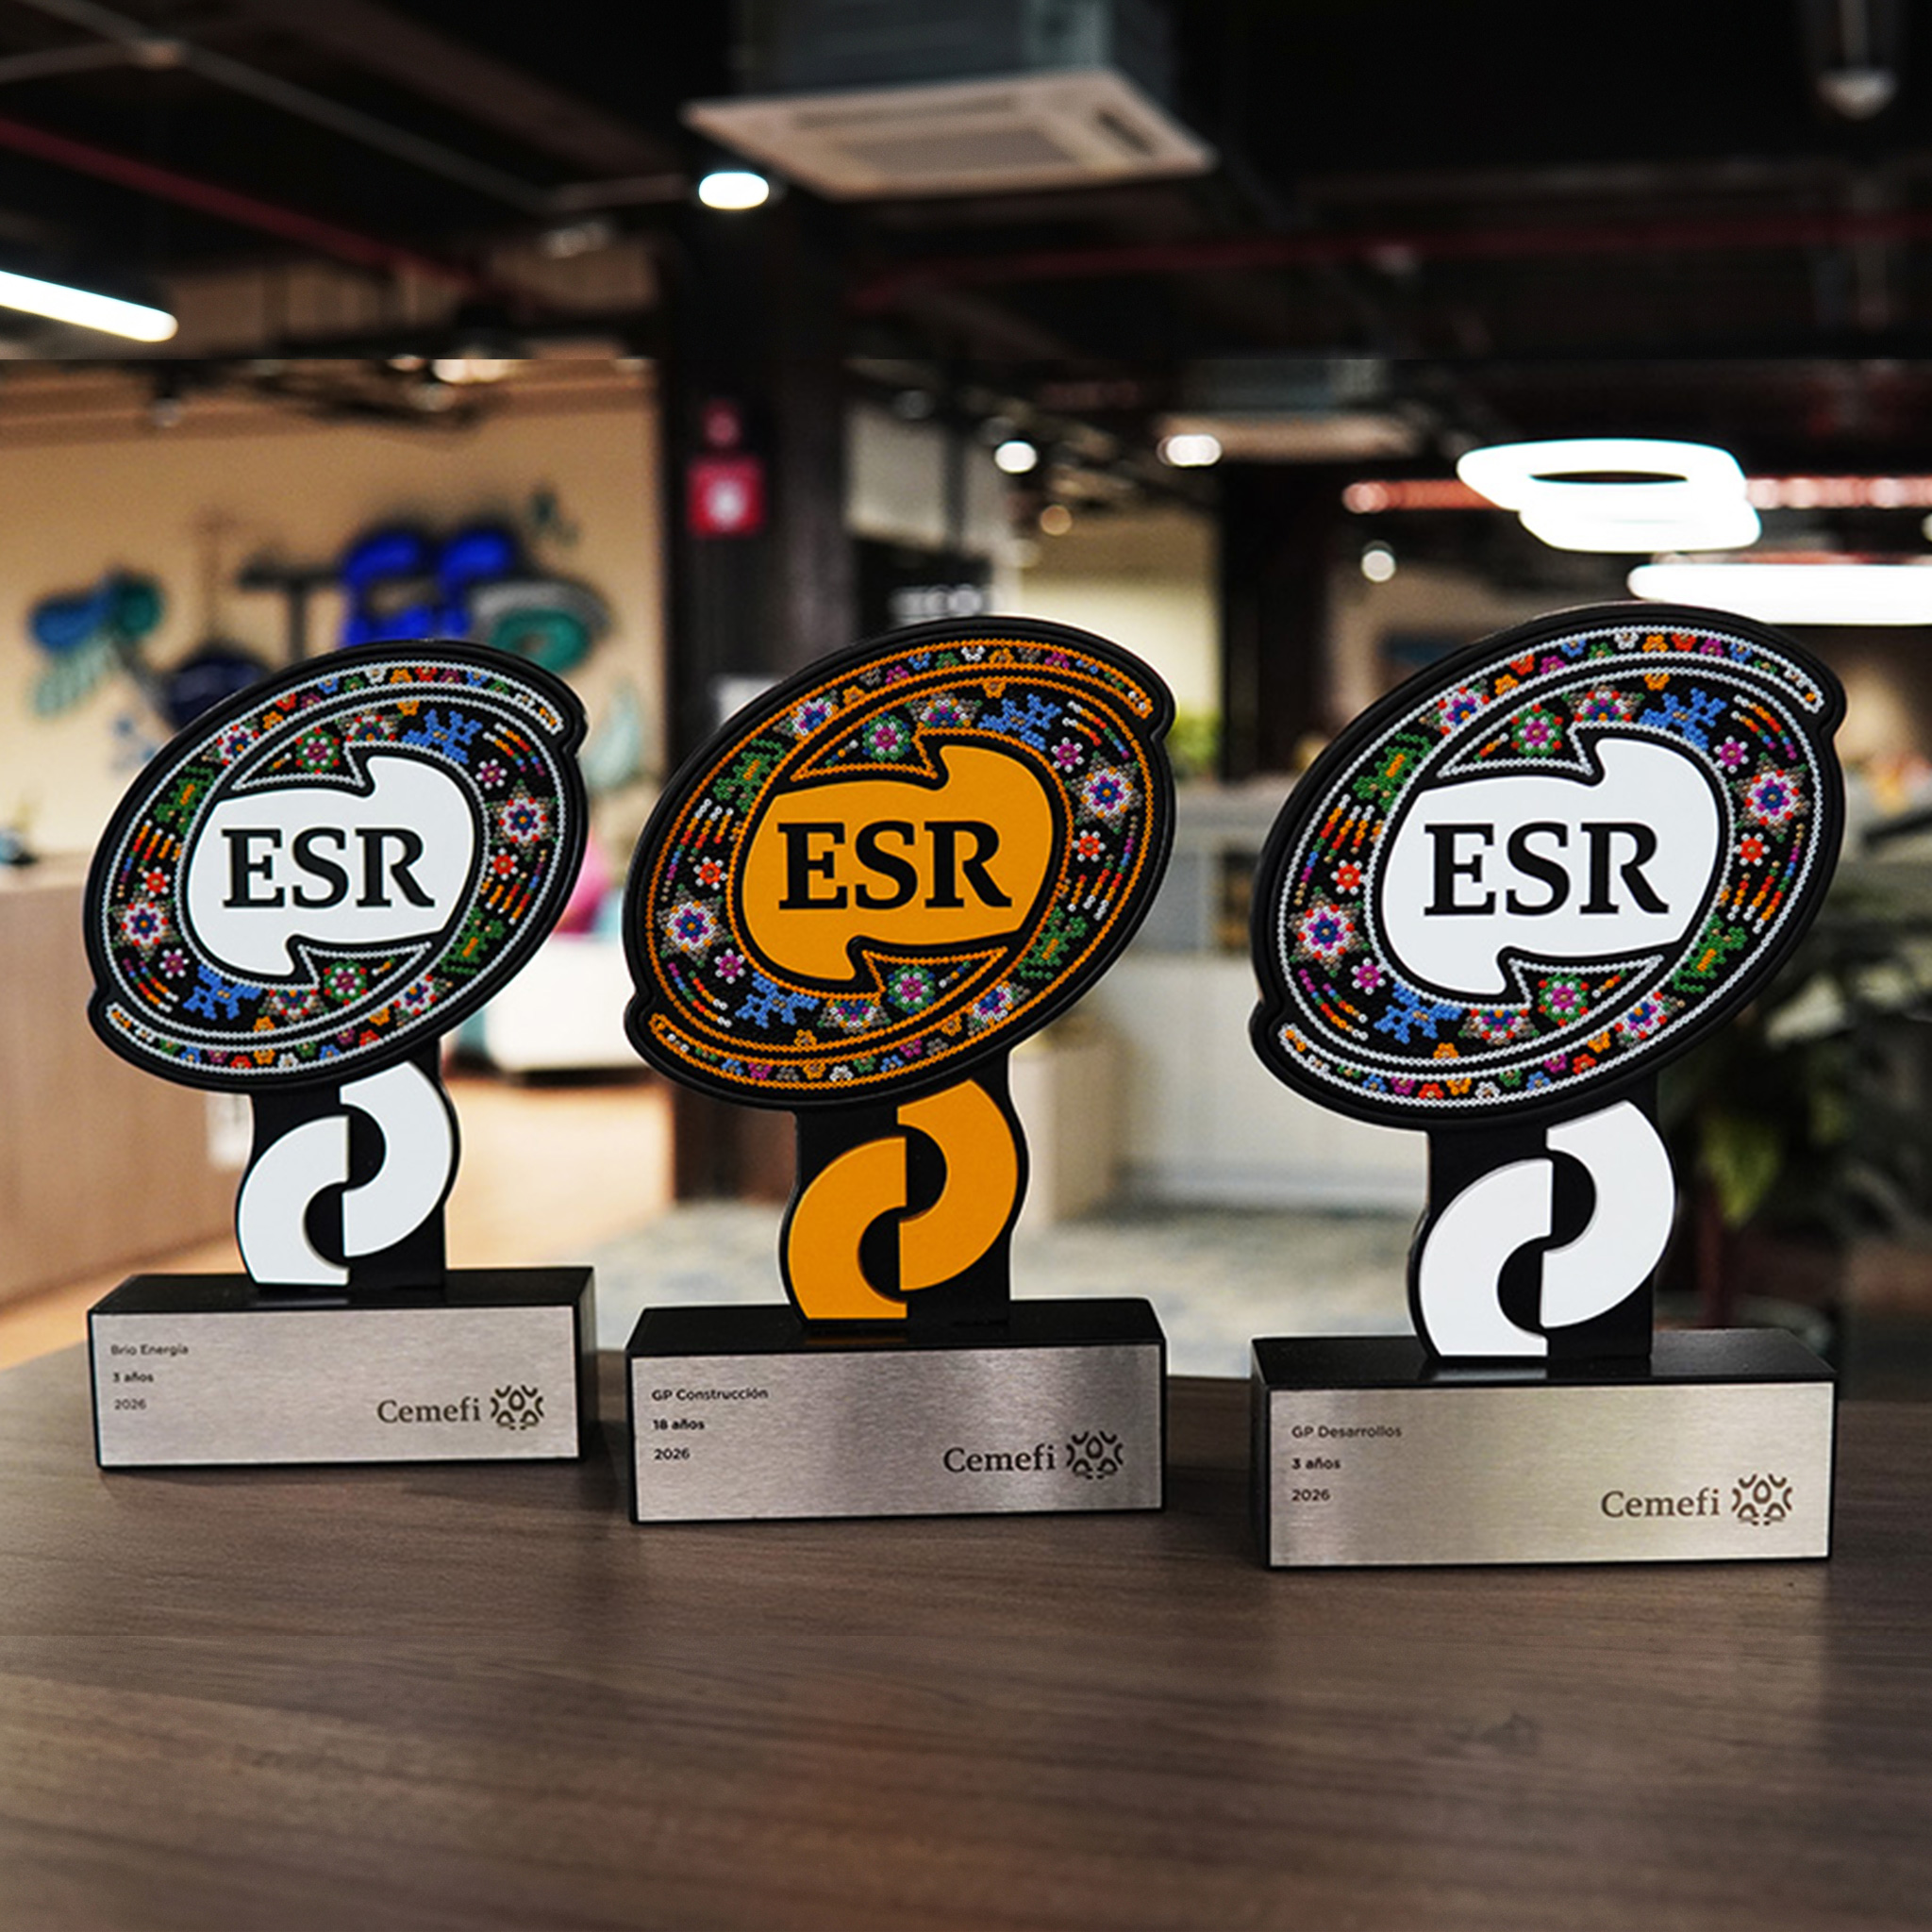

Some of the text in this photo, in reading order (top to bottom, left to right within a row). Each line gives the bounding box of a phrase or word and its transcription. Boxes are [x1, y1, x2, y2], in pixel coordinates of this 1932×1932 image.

[221, 826, 435, 908] ESR
[777, 820, 1012, 909] ESR
[1424, 821, 1669, 916] ESR
[110, 1344, 138, 1357] Brio
[113, 1371, 155, 1384] 3 años
[651, 1388, 769, 1401] GP Construcción
[114, 1398, 147, 1410] 2026
[377, 1396, 481, 1424] Cemefi
[653, 1418, 705, 1430] 18 años
[1291, 1424, 1403, 1439] GP Desarrollos
[654, 1447, 691, 1460] 2026
[943, 1444, 1056, 1473] Cemefi
[1291, 1457, 1341, 1470] 3 años
[1291, 1488, 1331, 1502] 2026
[1600, 1488, 1721, 1518] Cemefi
